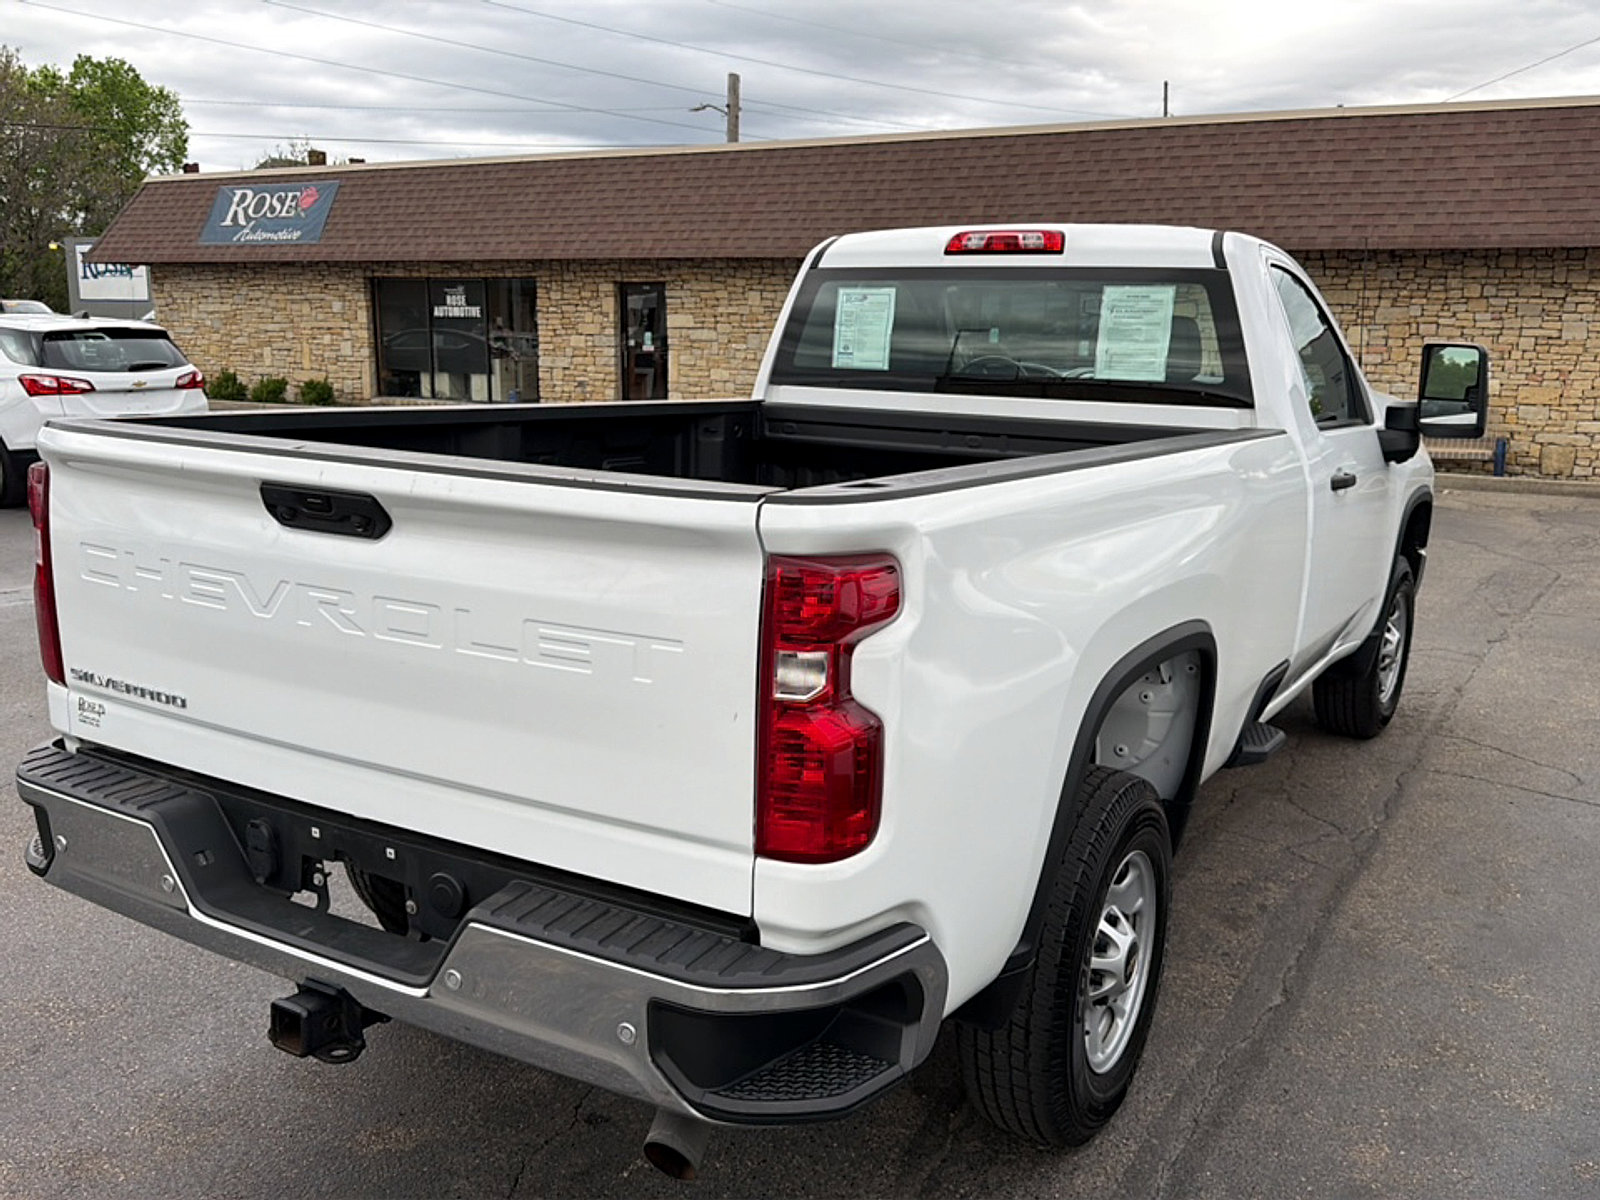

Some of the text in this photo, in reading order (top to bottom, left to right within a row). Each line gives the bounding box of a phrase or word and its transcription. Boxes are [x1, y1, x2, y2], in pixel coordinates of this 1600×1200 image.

[220, 189, 301, 226] ROSE
[232, 220, 302, 241] Automotive
[433, 306, 481, 318] AUTOMOTIVE
[446, 294, 467, 306] ROSE
[79, 541, 684, 684] CHEVROLET
[70, 668, 188, 709] SILVERADO
